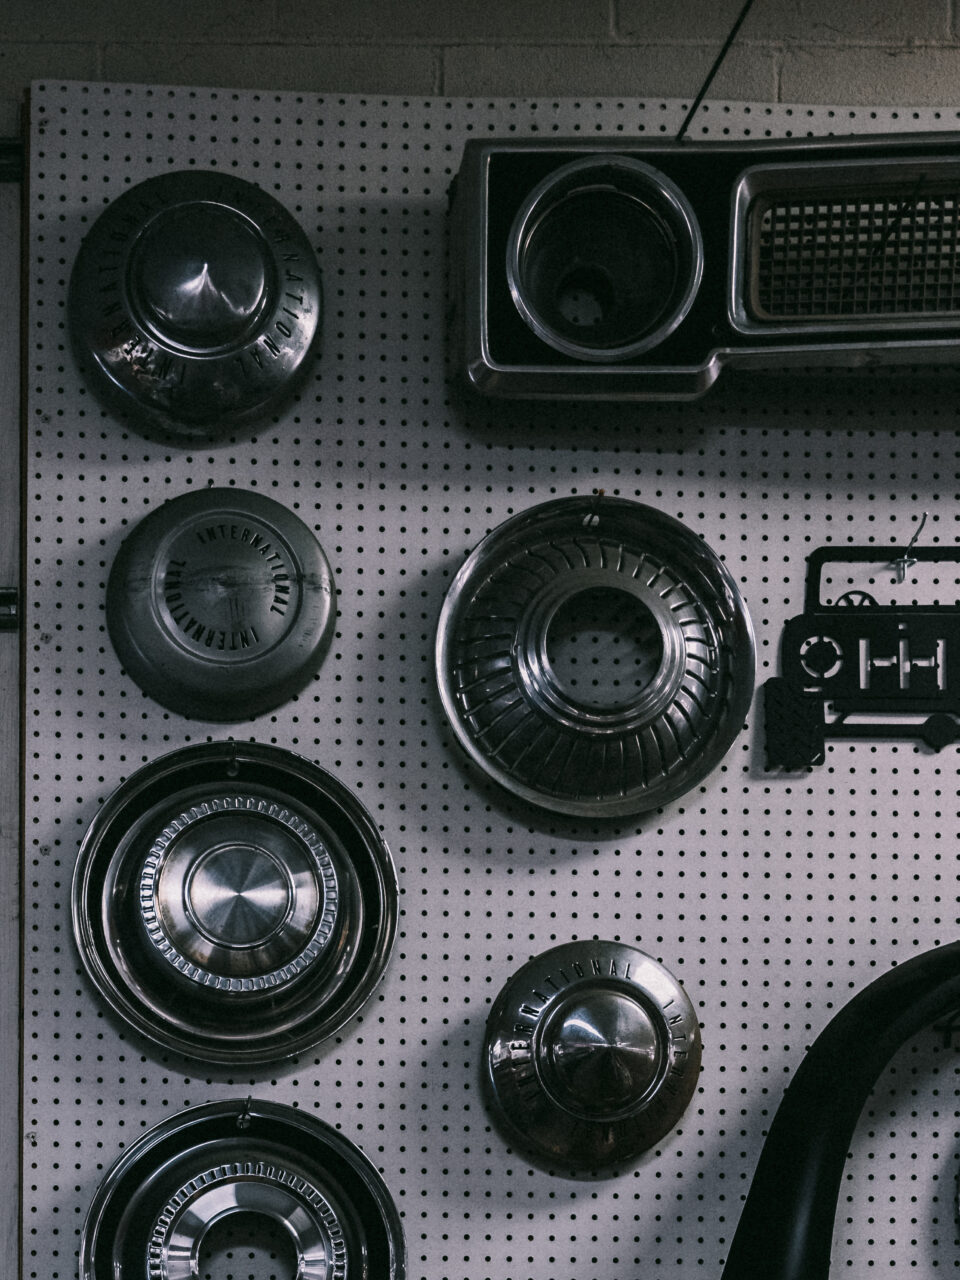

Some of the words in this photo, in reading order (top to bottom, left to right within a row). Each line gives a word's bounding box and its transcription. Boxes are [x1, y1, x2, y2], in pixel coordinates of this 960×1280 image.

[165, 558, 259, 651] INTERNATIONAL
[196, 524, 290, 617] INTERNATIONAL
[510, 959, 632, 1104] INTERNATIONAL
